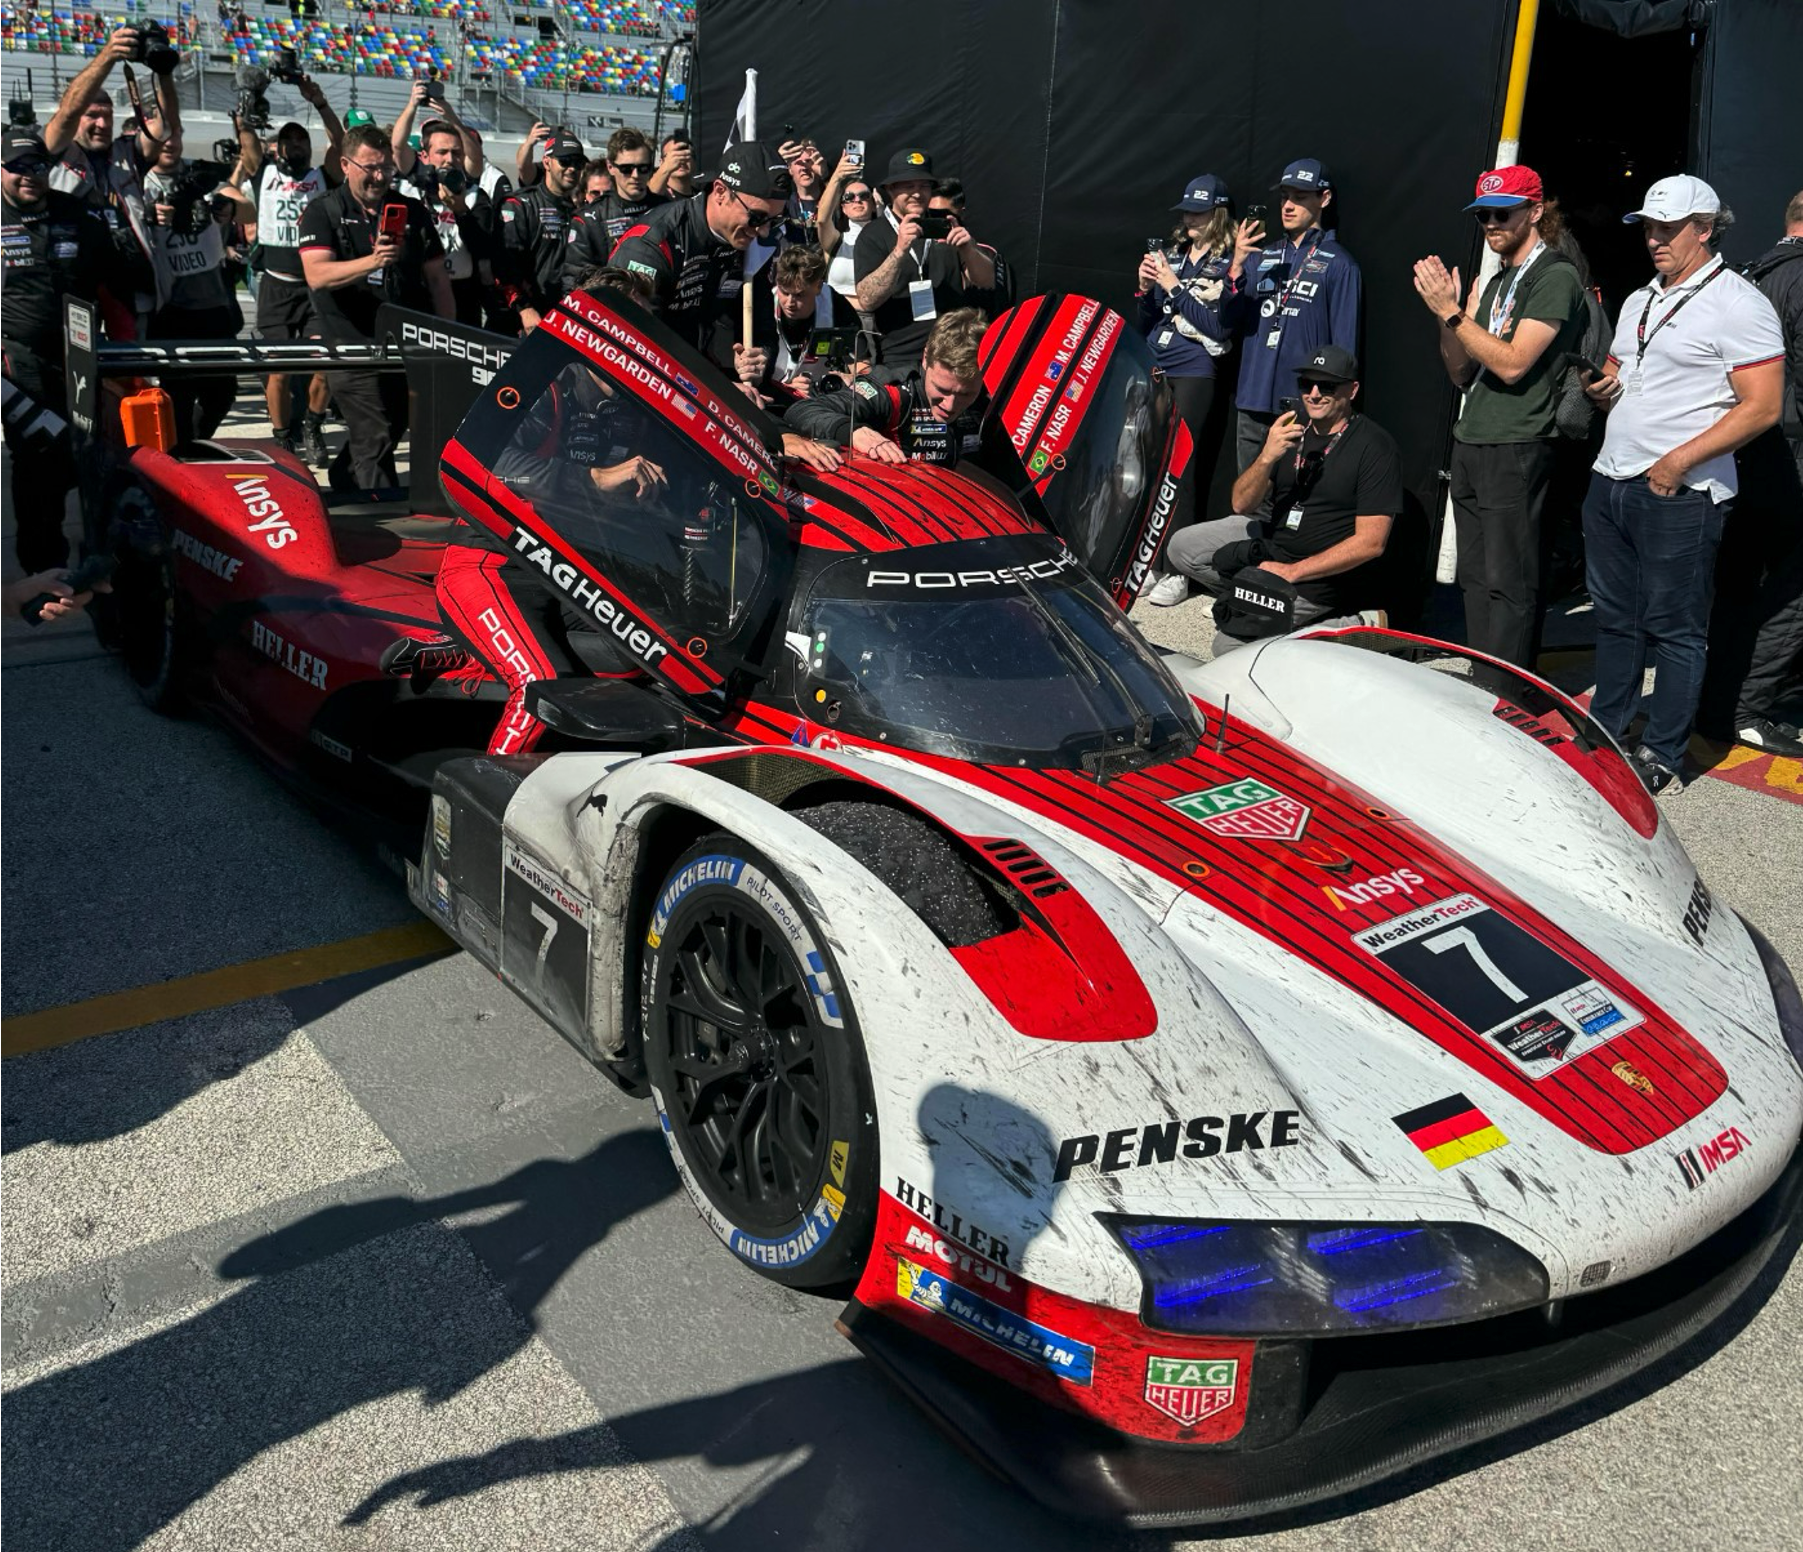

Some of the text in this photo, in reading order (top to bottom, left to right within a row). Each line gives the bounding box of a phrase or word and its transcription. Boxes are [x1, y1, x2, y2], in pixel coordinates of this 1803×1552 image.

[719, 171, 741, 187] Ansys
[1193, 190, 1209, 201] 22
[1297, 170, 1313, 182] 22
[1483, 177, 1501, 191] STP
[168, 250, 207, 271] VIDEO
[563, 294, 583, 315] M.
[587, 309, 673, 377] CAMPBELL
[708, 400, 721, 418] D.
[1054, 298, 1100, 365] M. CAMPBELL
[1080, 309, 1121, 385] J. NEWGARDEN
[543, 311, 758, 475] J. NEWGARDEN F. NASR
[1011, 384, 1052, 447] CAMERON
[913, 437, 947, 449] Ansys
[1040, 403, 1073, 453] F. NASR
[225, 474, 298, 549] Ansys
[171, 529, 244, 583] PENSKE
[866, 546, 1078, 588] PORSCHE
[1234, 586, 1286, 613] HELLER
[253, 620, 329, 691] HELLER
[1177, 784, 1272, 815] TAG
[1208, 800, 1301, 836] HEUER
[510, 853, 583, 919] WeatherTech
[663, 860, 735, 913] MICHELIN
[1321, 867, 1424, 912] Ansys
[530, 900, 559, 990] 7
[772, 902, 803, 942] SPORT
[1362, 899, 1480, 949] WeatherTech
[1420, 925, 1529, 1004] 7
[1507, 1020, 1562, 1051] WeatherTech
[1052, 1109, 1300, 1184] PENSKE
[1698, 1126, 1752, 1173] IMSA
[738, 1221, 820, 1264] MICHELIN
[896, 1175, 1010, 1269] HELLER
[904, 1224, 1012, 1293] MOTUL
[950, 1296, 1075, 1368] MICHELIN
[1156, 1360, 1229, 1385] TAG
[1150, 1387, 1232, 1418] HEUER
